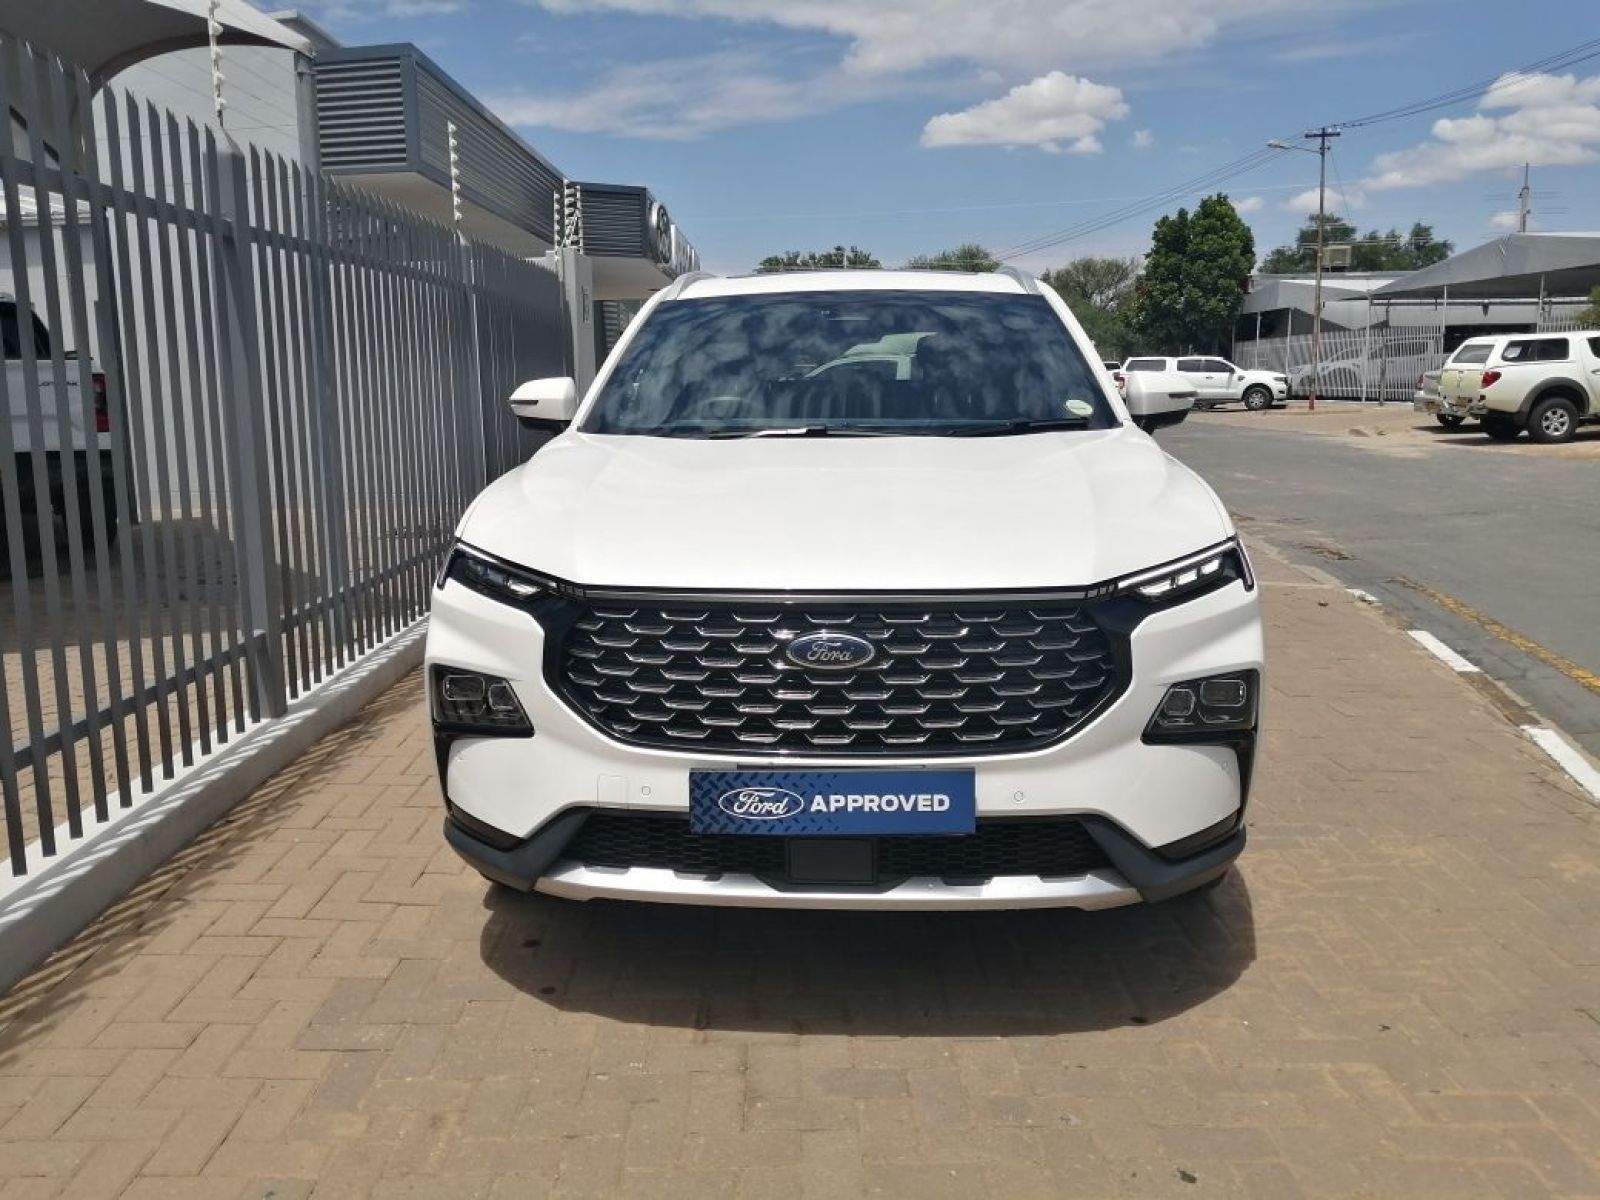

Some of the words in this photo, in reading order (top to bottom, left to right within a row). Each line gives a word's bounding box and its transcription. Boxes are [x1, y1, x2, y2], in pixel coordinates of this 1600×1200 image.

[807, 641, 853, 661] Ford
[734, 791, 789, 814] Ford
[810, 794, 951, 812] APPROVED
